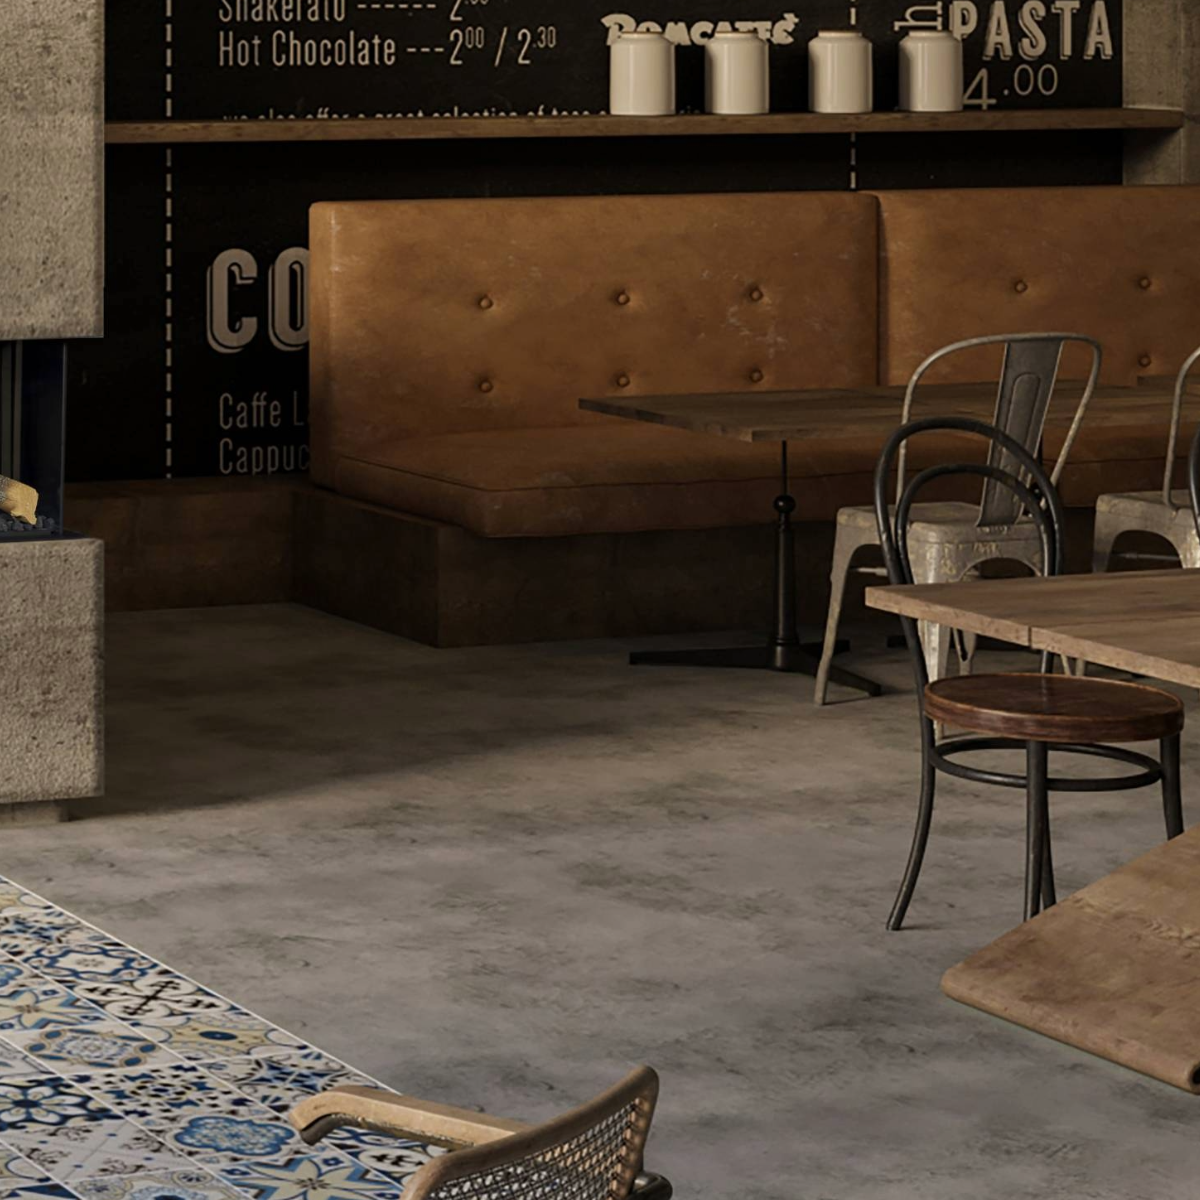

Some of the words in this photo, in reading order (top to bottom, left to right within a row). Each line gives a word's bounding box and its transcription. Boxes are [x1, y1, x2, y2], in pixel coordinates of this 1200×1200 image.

[218, 30, 261, 67] Hot
[271, 30, 396, 67] Chocolate
[951, 0, 1113, 60] PASTA
[962, 63, 1059, 111] 4.00
[219, 391, 282, 430] Caffe
